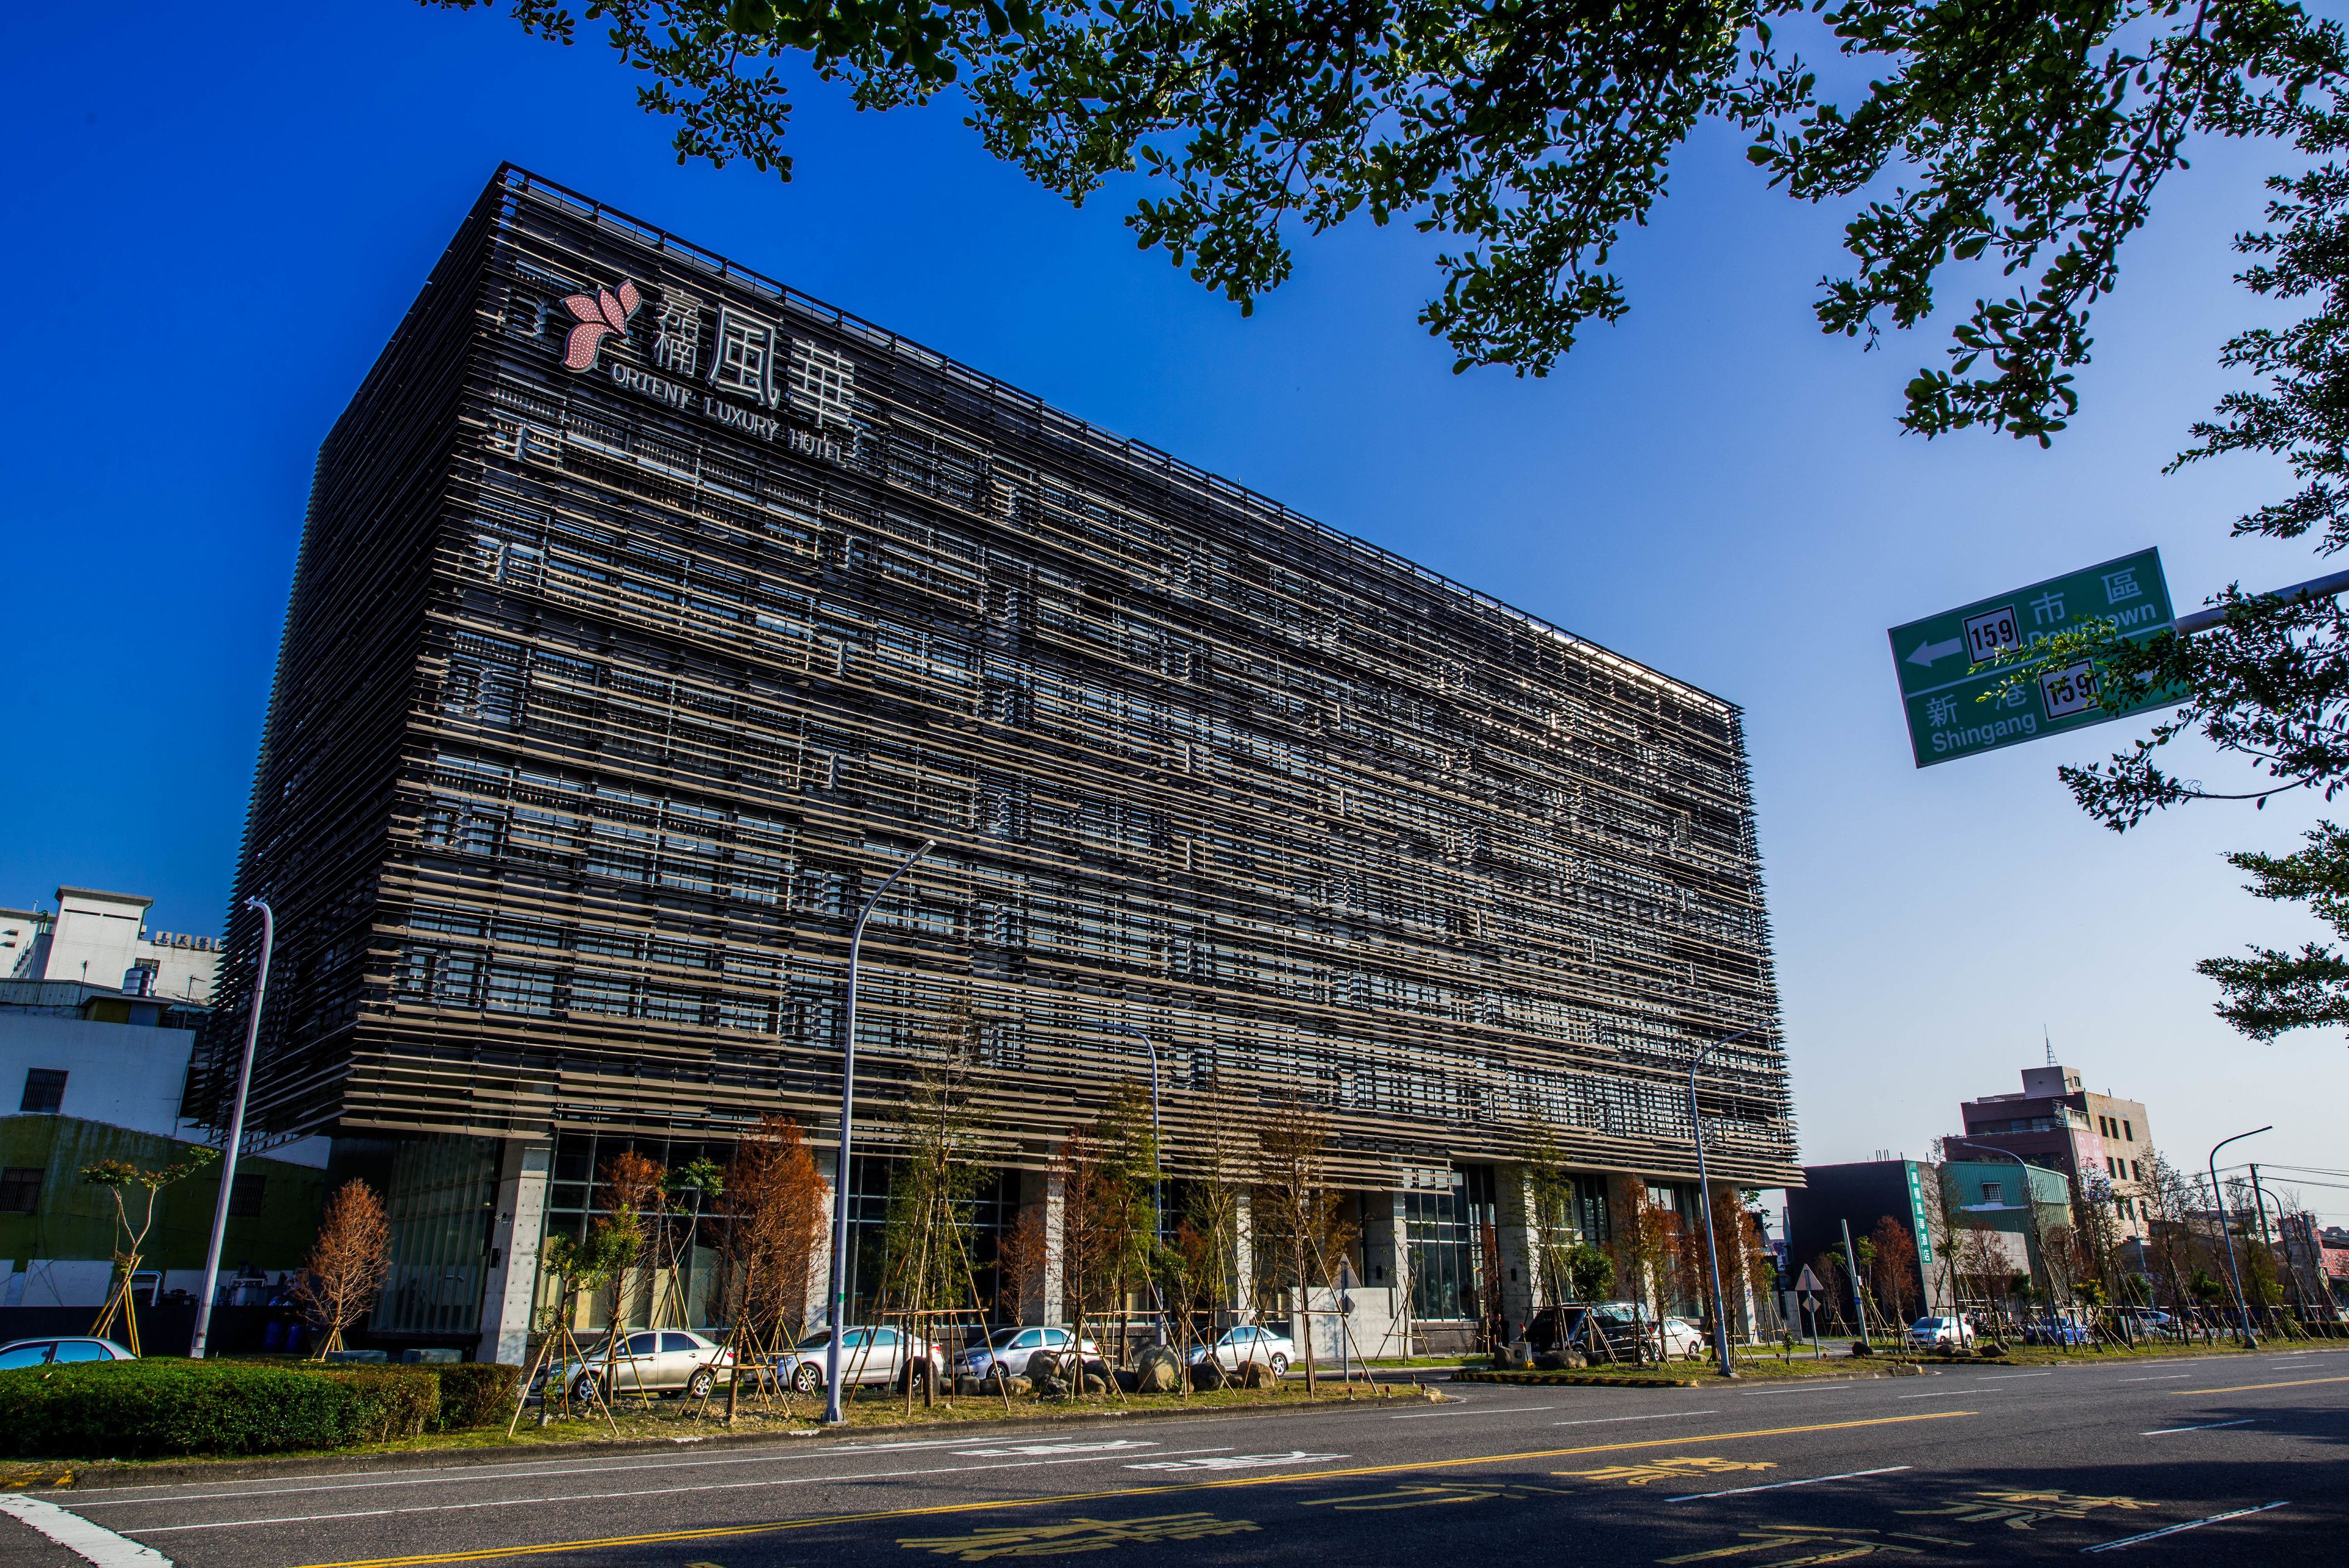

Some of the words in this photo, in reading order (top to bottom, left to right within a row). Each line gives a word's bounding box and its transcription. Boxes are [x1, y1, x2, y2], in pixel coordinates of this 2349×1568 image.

[652, 283, 855, 428] 嘉楠風華
[610, 362, 692, 409] ORIENT
[703, 396, 779, 441] LUXURY
[790, 427, 847, 468] HOTEL
[2029, 567, 2143, 625] 市區
[1970, 618, 2014, 651] 159
[1926, 678, 2027, 728] 新港
[2046, 673, 2091, 706] 159
[1931, 713, 2037, 752] Shingang
